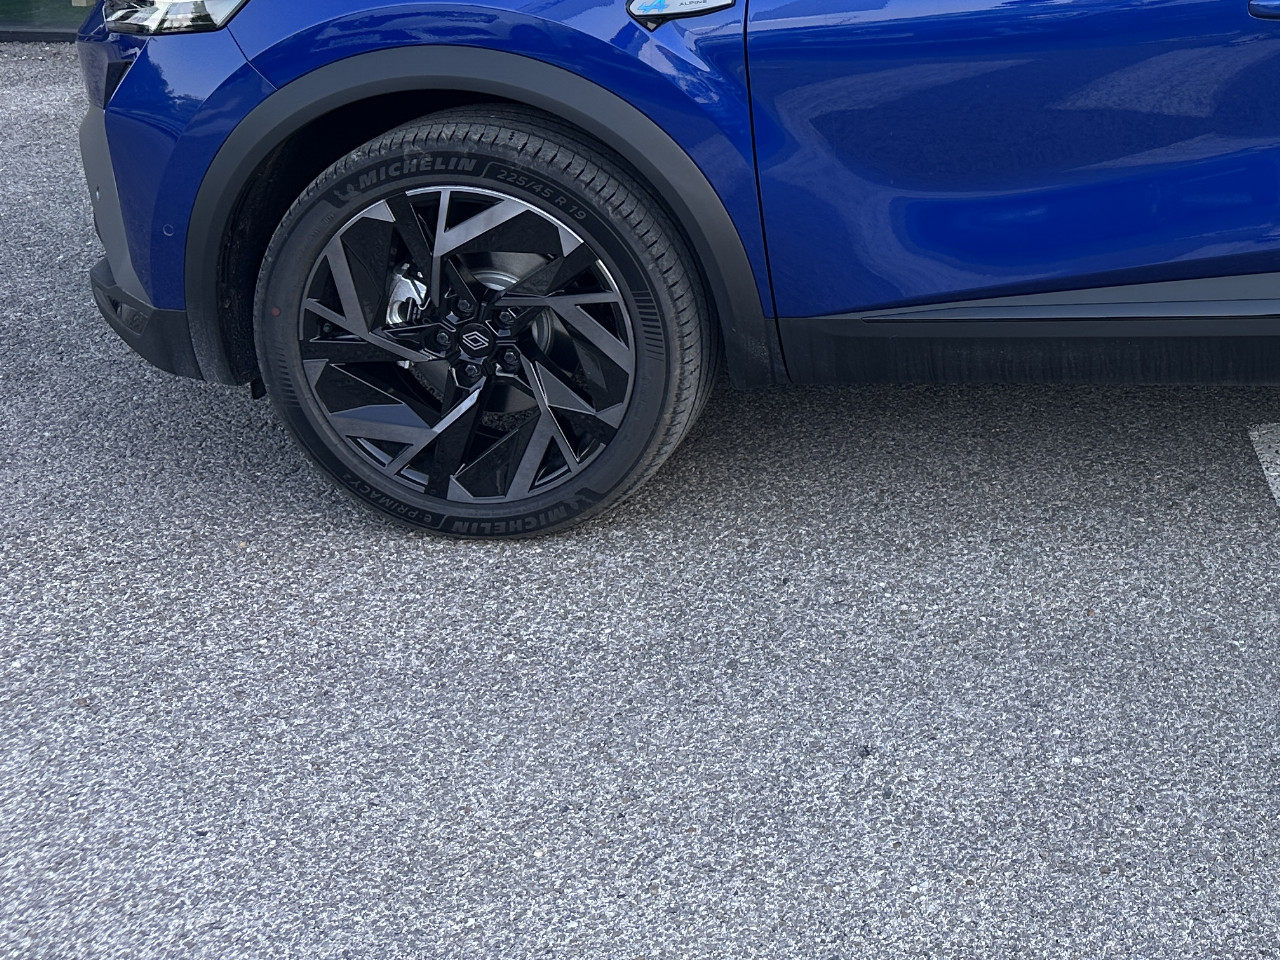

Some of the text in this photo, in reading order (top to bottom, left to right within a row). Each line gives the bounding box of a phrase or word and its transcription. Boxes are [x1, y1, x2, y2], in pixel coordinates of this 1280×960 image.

[678, 0, 707, 7] ALPINE
[358, 157, 477, 190] MICHELIN
[496, 169, 588, 221] 225/45 R 19
[452, 506, 568, 534] MICHELIN
